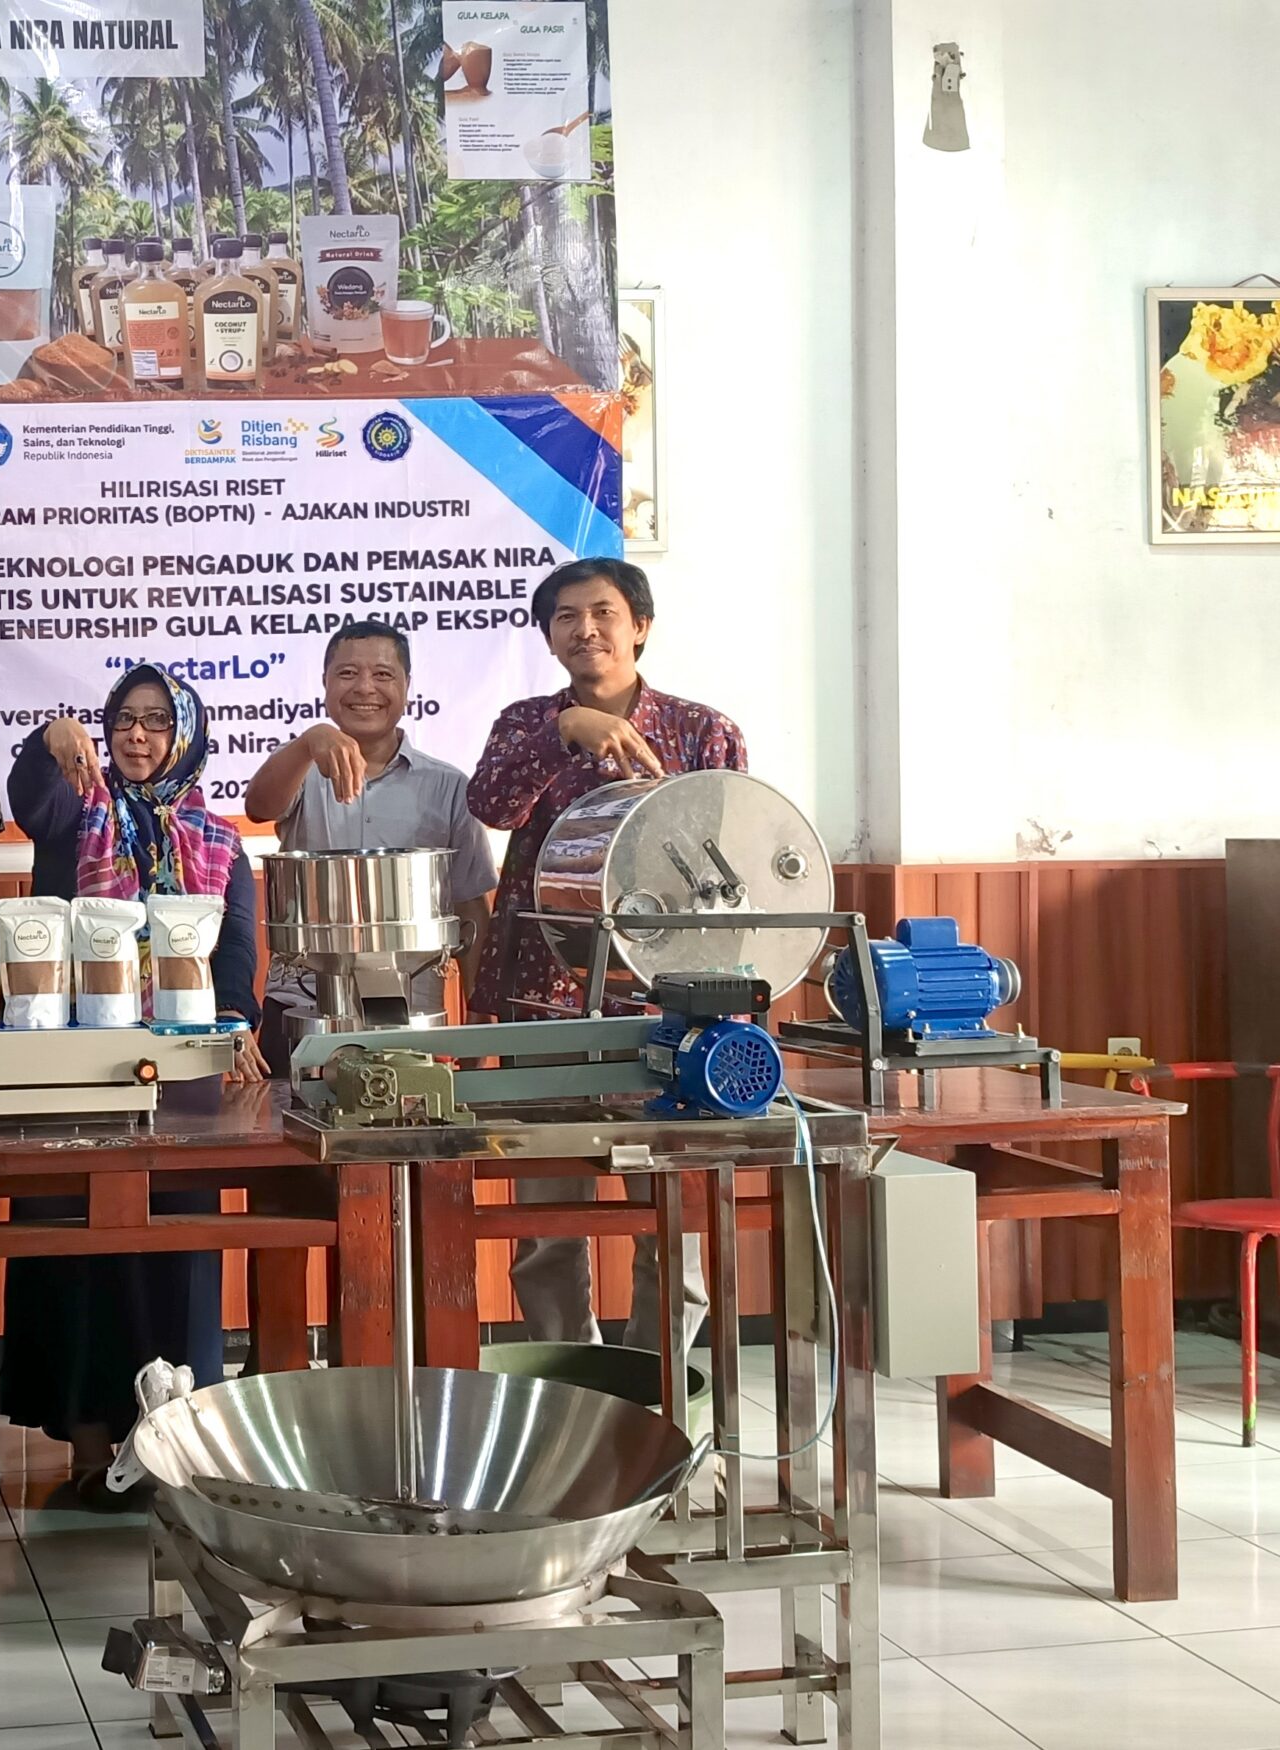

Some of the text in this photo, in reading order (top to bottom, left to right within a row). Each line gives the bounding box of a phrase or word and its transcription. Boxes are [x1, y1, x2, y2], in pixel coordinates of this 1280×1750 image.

[457, 11, 510, 20] GULA KELAPA
[9, 19, 65, 50] NIRA
[72, 18, 179, 50] NATURAL
[520, 25, 565, 34] GULA PASIR
[328, 228, 370, 239] NectarLo
[211, 299, 252, 309] NectarLo
[213, 320, 248, 328] COCONUT
[22, 423, 175, 435] Kementerian Pendidikan Tinggi,
[241, 420, 282, 435] Ditjen
[23, 437, 126, 448] Sains, dan Teknologi
[241, 434, 298, 449] Risbang
[23, 450, 113, 461] Republik Indonesia
[184, 448, 236, 456] DIKTISAINTEK
[184, 456, 237, 464] BERDAMPAK
[100, 479, 286, 498] HILIRISASI RISET
[42, 505, 159, 525] PRIORITAS
[165, 502, 256, 527] (BOPTN)
[281, 502, 369, 521] AJAKAN
[374, 499, 470, 519] INDUSTRI
[142, 552, 295, 577] PENGADUK
[303, 551, 359, 573] DAN
[366, 548, 487, 571] PEMASAK
[493, 546, 556, 568] NIRA
[41, 587, 139, 611] UNTUK
[146, 583, 331, 609] REVITALISASI
[340, 578, 527, 604] SUSTAINABLE
[165, 615, 242, 637] GULA
[228, 732, 280, 754] Nira
[17, 933, 48, 941] NectarLo
